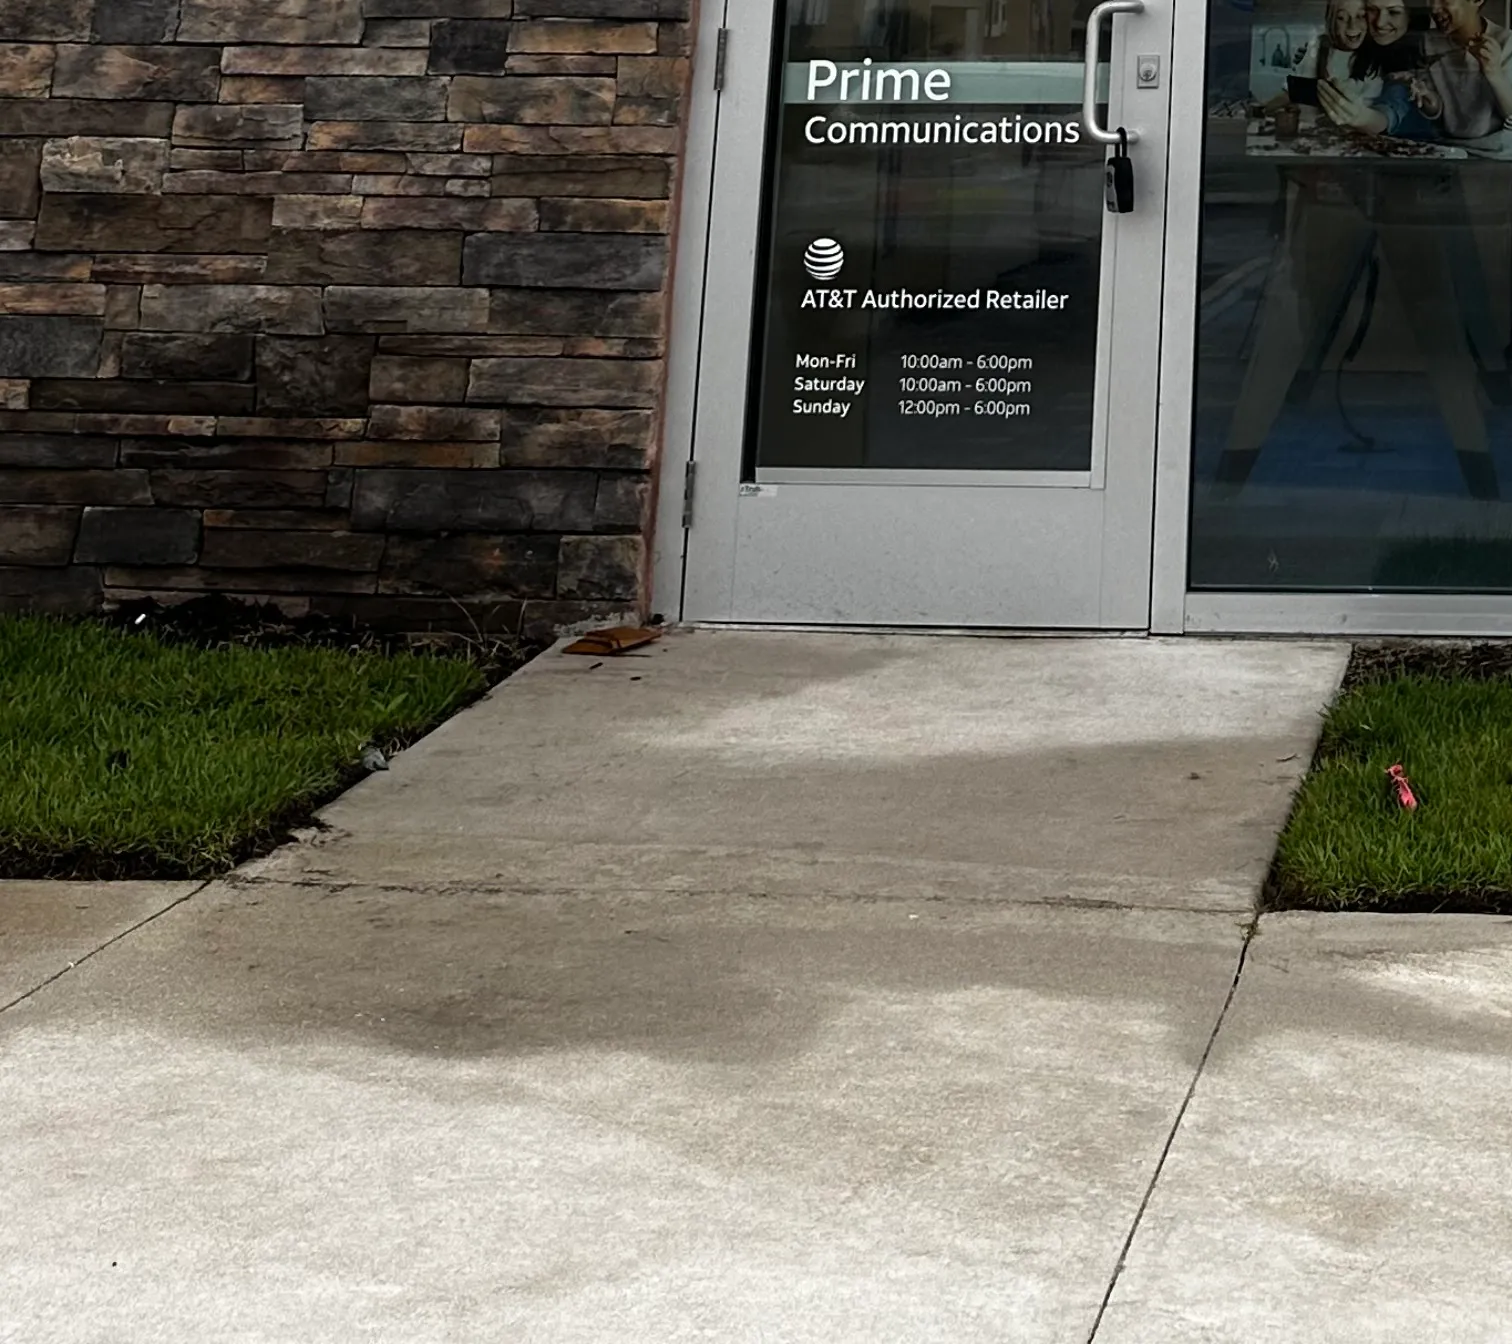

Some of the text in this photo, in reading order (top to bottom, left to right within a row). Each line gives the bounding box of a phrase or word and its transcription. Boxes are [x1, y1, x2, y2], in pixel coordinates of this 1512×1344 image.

[805, 57, 952, 102] Prime
[804, 115, 1081, 144] Communications
[800, 288, 1069, 310] AT&T Authorized Retailer
[795, 353, 856, 369] Mon-Fri
[900, 354, 963, 370] 10:00am
[976, 354, 1033, 373] 6:00pm
[794, 376, 865, 395] Saturday
[899, 377, 962, 392] 10:00am
[975, 377, 1032, 396] 6:00pm
[792, 399, 851, 418] Sunday
[898, 399, 960, 418] 12:00pm
[974, 400, 1030, 419] 6:00pm
